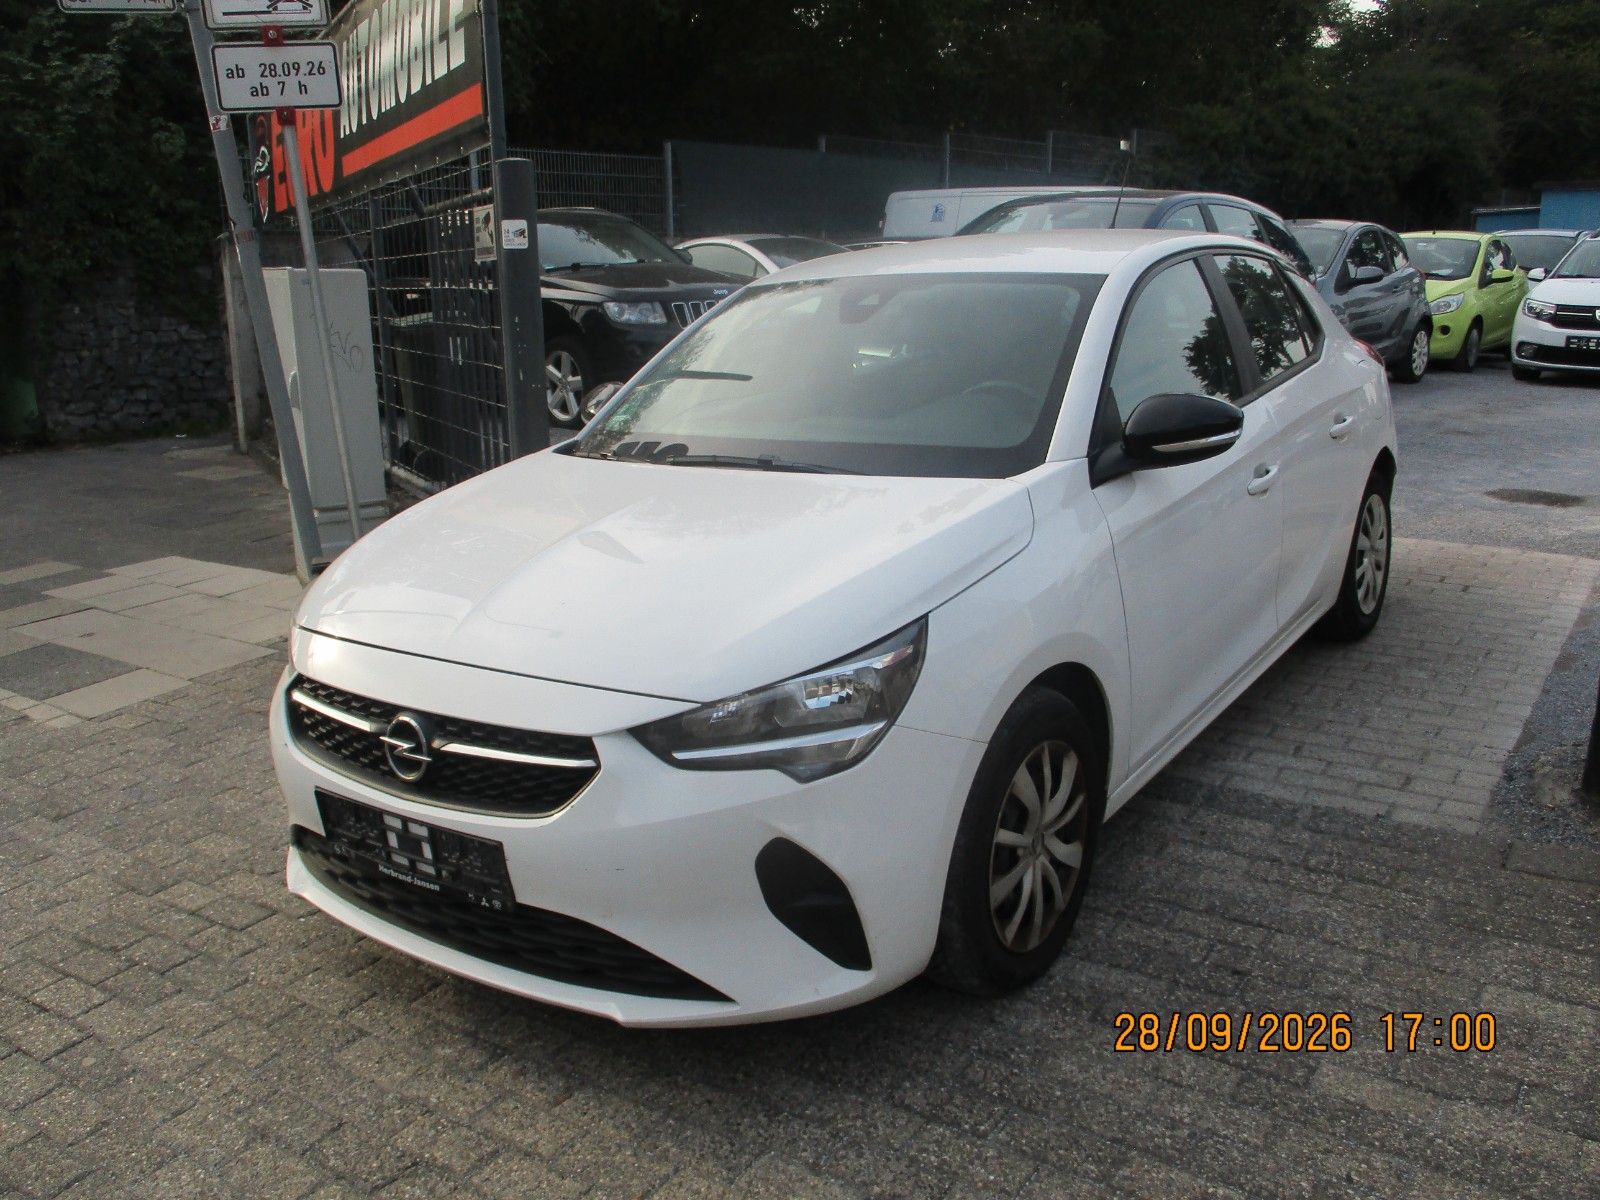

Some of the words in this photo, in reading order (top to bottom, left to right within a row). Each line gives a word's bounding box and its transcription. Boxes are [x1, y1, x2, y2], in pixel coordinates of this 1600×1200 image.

[225, 64, 246, 79] ab
[258, 61, 326, 78] 28.09.26
[340, 0, 467, 139] AUTOMOBILE
[249, 82, 270, 97] ab
[277, 81, 286, 96] 7
[298, 80, 308, 95] h
